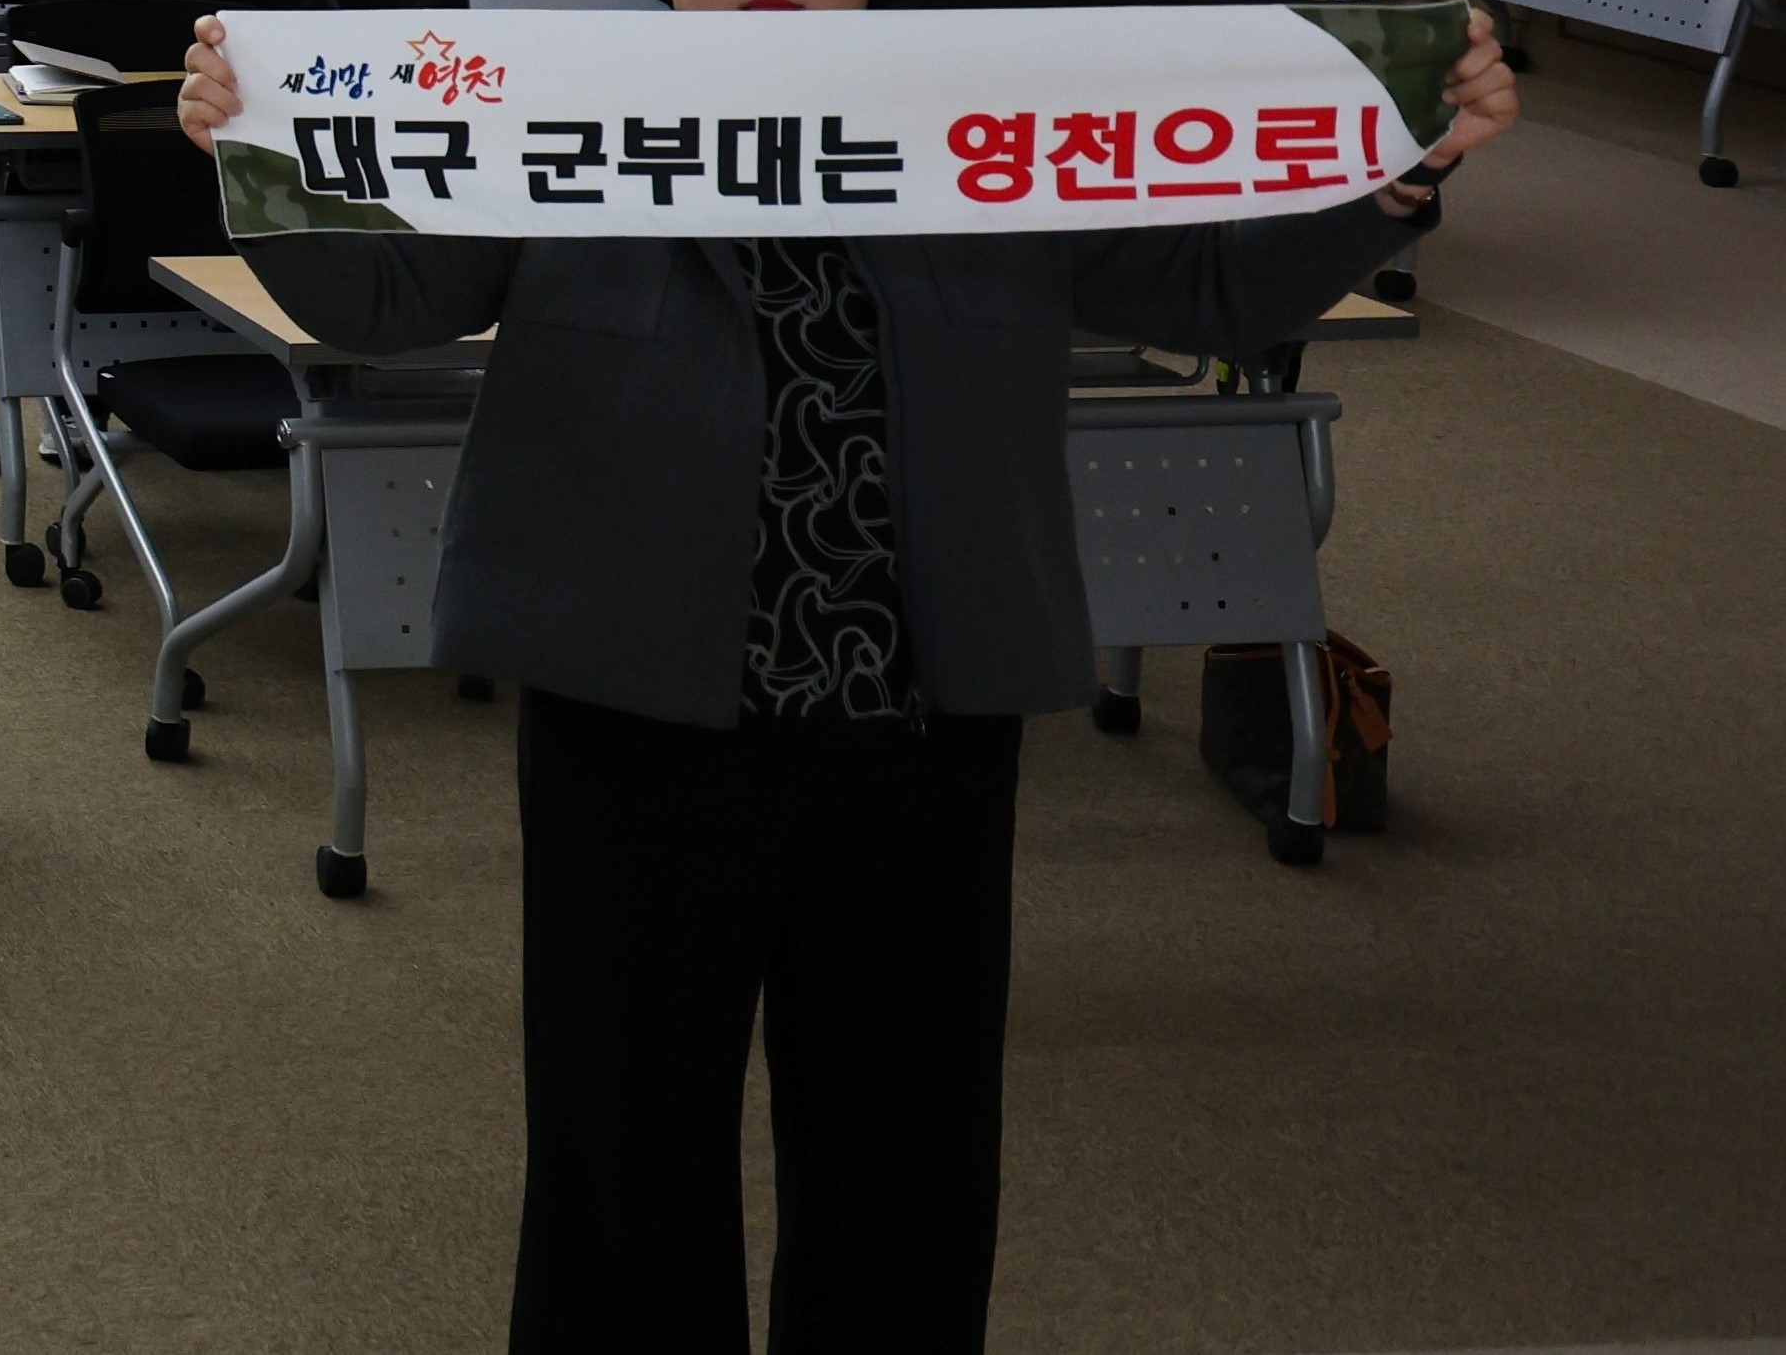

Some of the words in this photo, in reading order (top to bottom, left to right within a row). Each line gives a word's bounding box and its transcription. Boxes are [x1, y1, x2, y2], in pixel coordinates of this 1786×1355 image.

[295, 116, 478, 204] 대구
[518, 116, 905, 206] 군부대는
[945, 104, 1382, 204] 영천으로!
